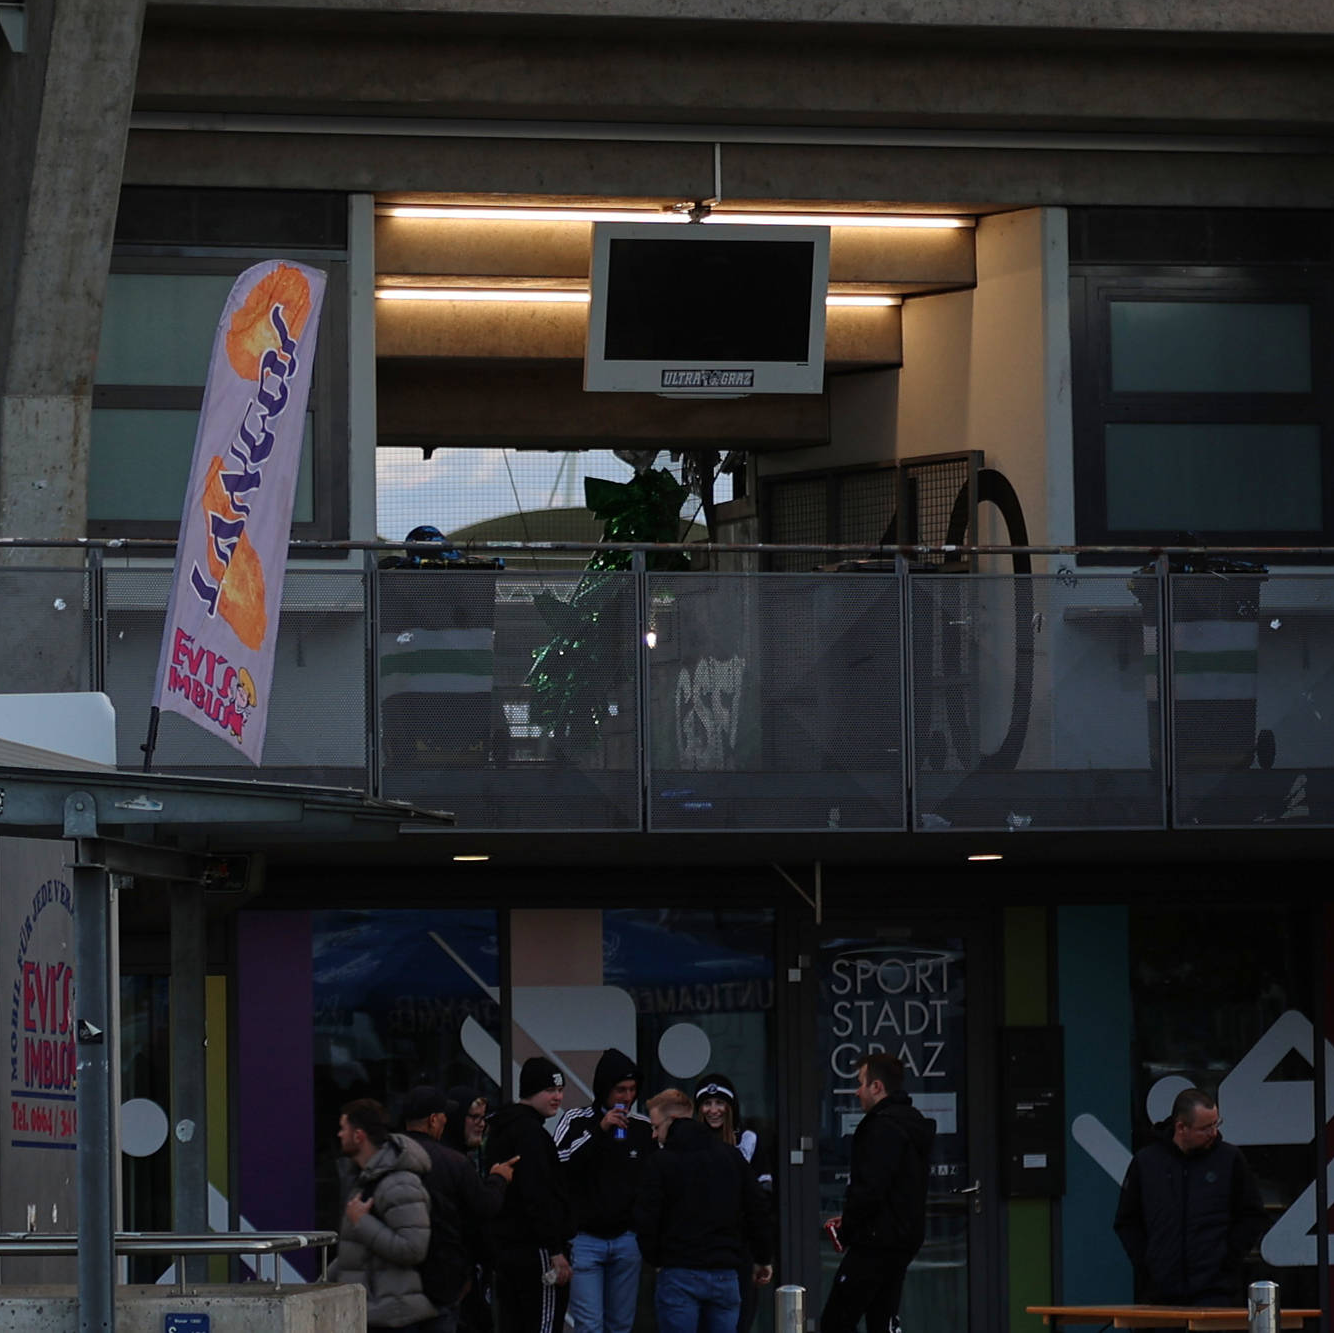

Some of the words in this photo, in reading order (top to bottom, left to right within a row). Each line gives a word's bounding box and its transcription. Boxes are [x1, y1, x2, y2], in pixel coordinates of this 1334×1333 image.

[663, 370, 702, 386] ULTRA
[720, 370, 754, 386] GRAZ
[830, 957, 955, 995] SPORT
[832, 999, 949, 1038] STADT
[11, 1101, 29, 1132] Tel.
